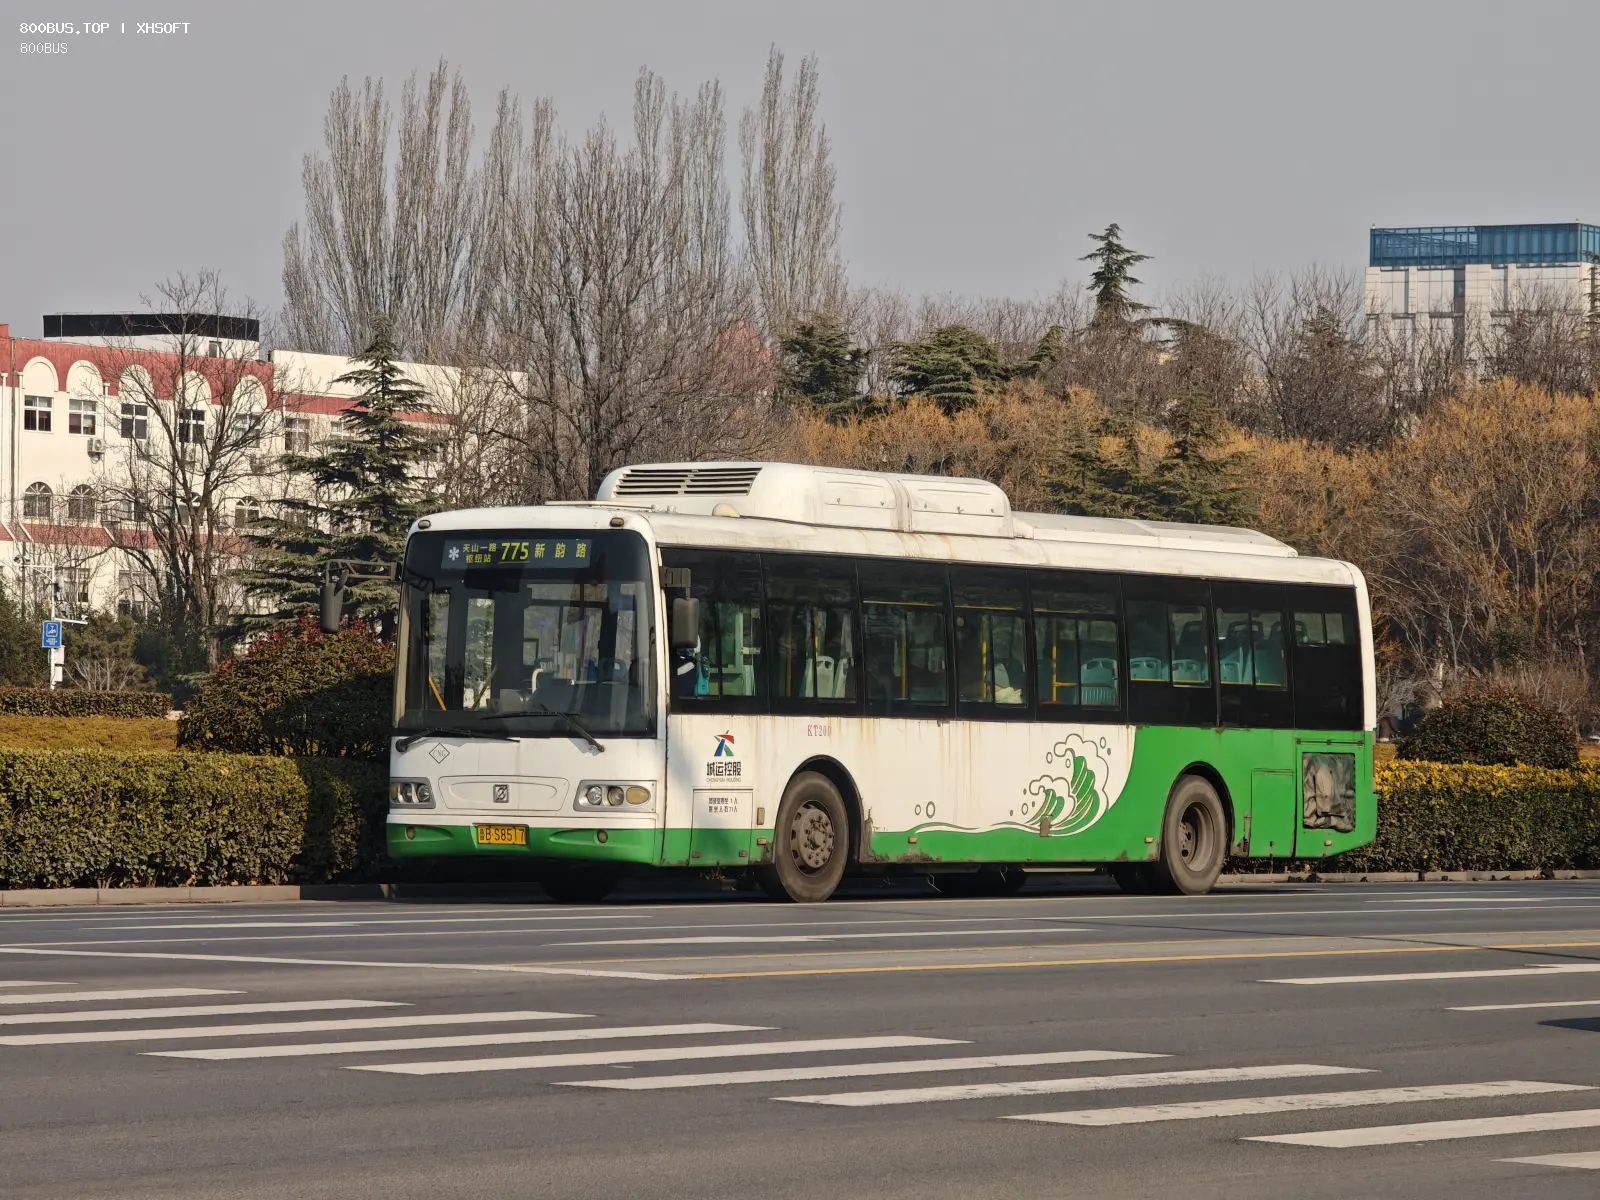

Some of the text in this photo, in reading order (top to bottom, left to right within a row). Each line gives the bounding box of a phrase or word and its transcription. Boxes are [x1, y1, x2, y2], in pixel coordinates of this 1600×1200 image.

[462, 543, 497, 553] 天山一路
[501, 542, 587, 561] 775 新韵路
[706, 761, 742, 777] 城运控股
